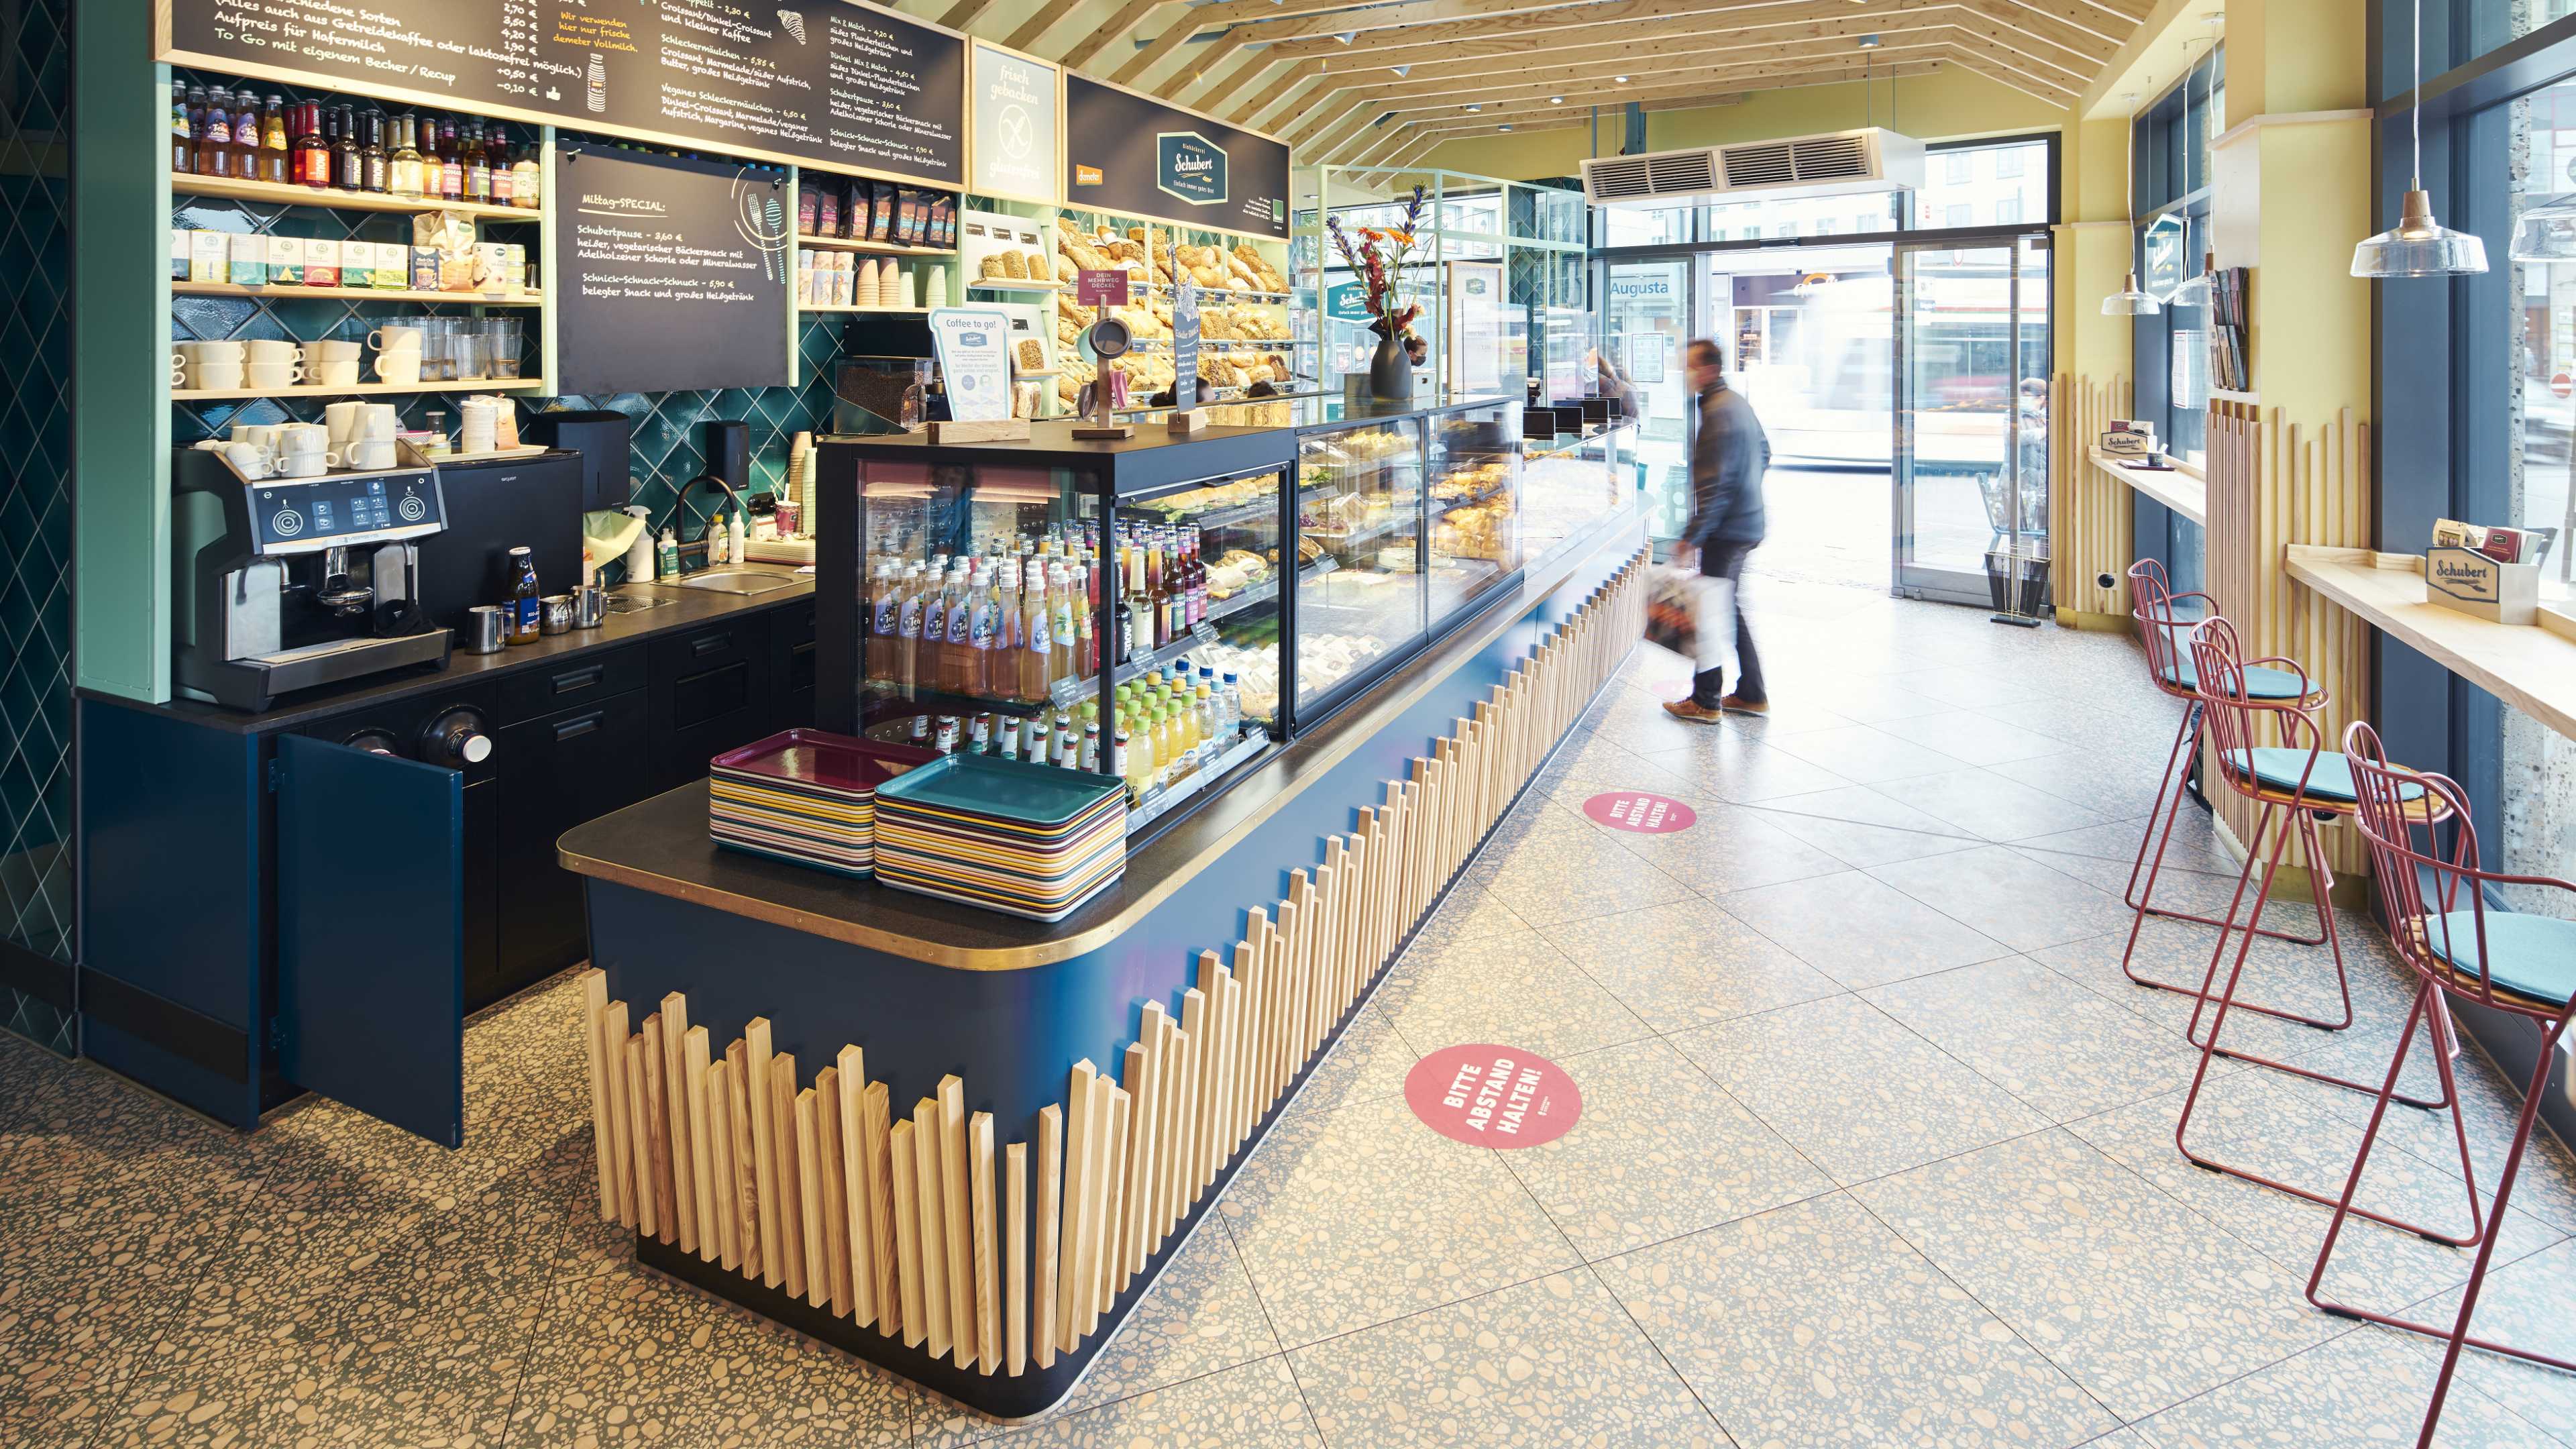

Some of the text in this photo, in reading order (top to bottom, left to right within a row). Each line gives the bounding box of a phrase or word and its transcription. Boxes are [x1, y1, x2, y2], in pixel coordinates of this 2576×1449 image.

[360, 9, 401, 27] Sorten
[504, 3, 525, 15] 2,70
[529, 9, 537, 19] €
[561, 11, 627, 28] Wir verwenden
[724, 6, 741, 15] 2,30
[215, 11, 386, 54] Aufpreis für Hafermilch
[503, 16, 538, 31] 3,50 €
[558, 21, 631, 39] hier nur frische
[661, 14, 751, 43] und kleiner Kaffee
[830, 16, 841, 24] Mix
[848, 21, 865, 32] Match
[265, 6, 299, 19] auch
[303, 13, 327, 25] aus
[331, 17, 433, 48] Getreidekaffee
[437, 41, 466, 54] oder
[469, 46, 530, 66] laktosefrei
[533, 60, 582, 78] möglich.)
[501, 28, 538, 44] 4,20 €
[553, 34, 638, 52] demeter Vollmilch.
[830, 26, 912, 56] süßes Plunderteilchen und
[215, 28, 234, 40] To
[240, 34, 266, 46] Go
[272, 40, 297, 52] mit
[303, 46, 360, 64] eigenem
[365, 56, 408, 72] Becher
[420, 67, 456, 87] Recup
[504, 42, 537, 56] 1,90 €
[661, 34, 741, 60] Schleckermäulchen
[830, 36, 891, 59] großes Heißgetränk
[661, 47, 810, 90] Croissant, Marmelade/süßer Aufstrich,
[661, 57, 770, 88] Butter, großes Heißgetränk
[830, 52, 851, 63] Dinkel
[871, 62, 888, 72] Match
[496, 67, 539, 83] +0,50 €
[830, 62, 920, 92] süßes Dinkel-Plunderteilchen
[830, 72, 906, 96] und großes Heißgetränk
[1000, 64, 1030, 86] frisch
[529, 87, 538, 97] €
[661, 83, 696, 98] Veganes
[699, 91, 773, 114] Schleckermäulchen
[784, 109, 798, 118] 6,50
[830, 88, 873, 105] Schubertpause
[881, 101, 894, 109] 3,60
[990, 80, 1039, 105] gebacken
[661, 96, 808, 132] Dinkel-Croissant, Marmelade/veganer
[854, 106, 894, 119] vegetarischer
[896, 114, 931, 127] Bäckersnack
[661, 106, 822, 144] Aufstrich, Margarine, veganes Heißgetränk
[830, 109, 873, 123] Adelholzener
[875, 118, 896, 129] Schorle
[914, 127, 952, 141] Mineralwasser
[830, 129, 908, 150] Schnick-Schnack-Schnuck
[830, 138, 856, 151] belegter
[858, 144, 876, 154] Snack
[878, 149, 890, 157] und
[914, 156, 947, 168] Heißgetränk
[1175, 153, 1213, 172] Schubert
[1079, 170, 1100, 182] demeter
[582, 194, 665, 212] Mittag-SPECIAL:
[577, 225, 683, 241] Schubertpause 3,60 €
[577, 238, 743, 259] heißer, vegetarischer Bäckersnack mit
[578, 250, 757, 269] Adelholzener Schorle oder Mineralwasser
[582, 274, 698, 286] Schnick-Schnack-Schnuck
[1610, 282, 1668, 297] Augusta
[582, 284, 754, 303] belegter Snack und großes Heißgetränk
[946, 319, 971, 327] Coffee
[984, 321, 996, 330] go!
[2108, 437, 2141, 446] Schubert
[2436, 559, 2487, 578] Schubert
[1609, 800, 1631, 818] BITTE
[1626, 798, 1650, 826] ABSTAND
[1646, 802, 1669, 828] HALTEN!
[1443, 1063, 1482, 1108] BITTE
[1465, 1059, 1515, 1132] ABSTAND
[1496, 1068, 1542, 1134] HALTEN!
